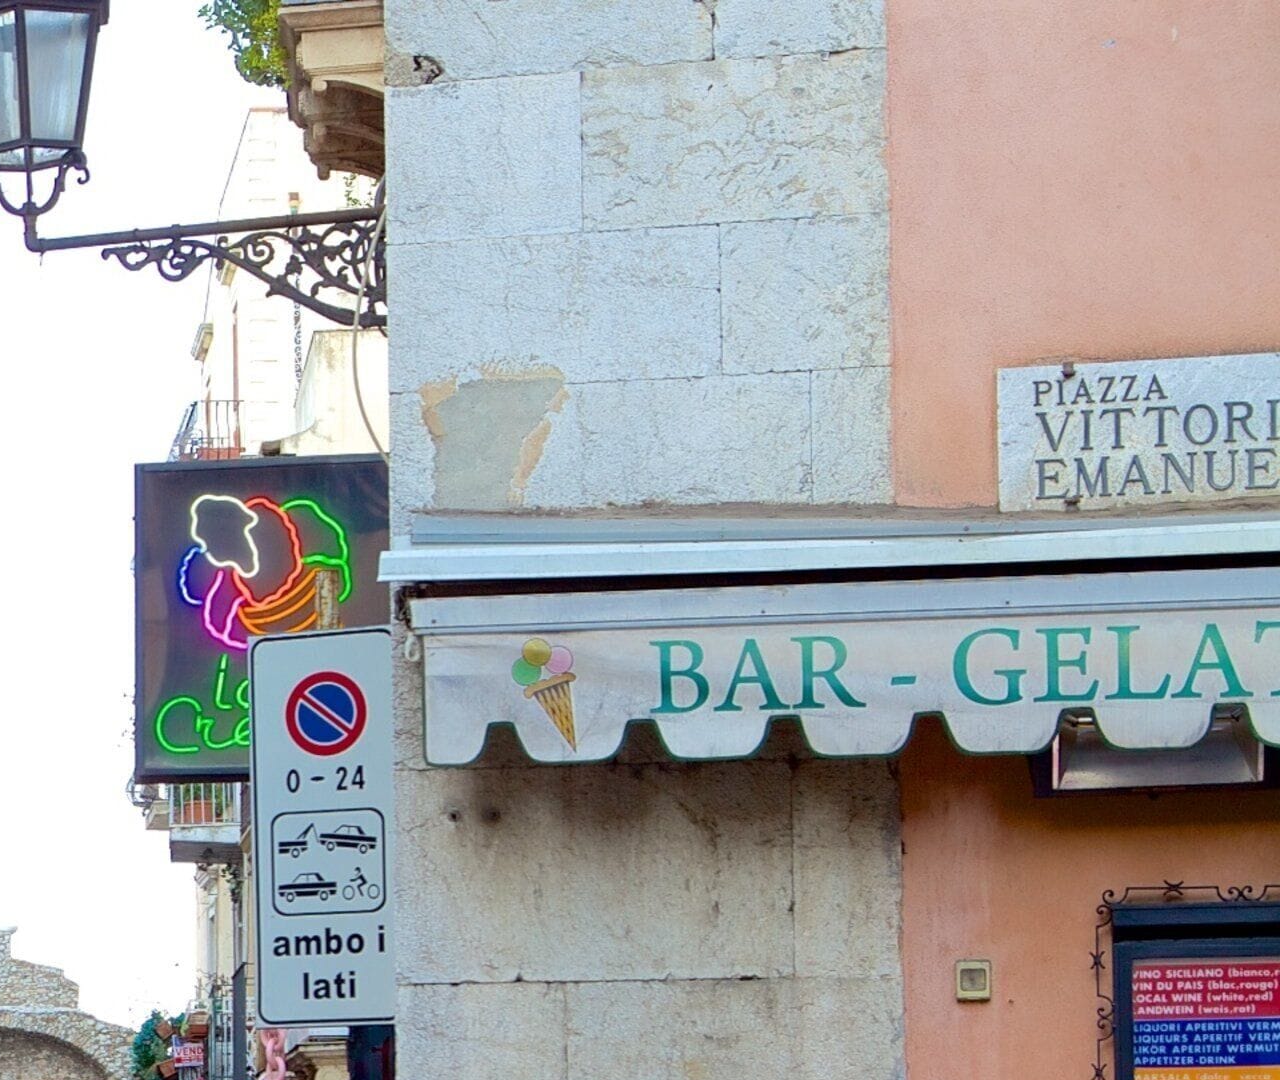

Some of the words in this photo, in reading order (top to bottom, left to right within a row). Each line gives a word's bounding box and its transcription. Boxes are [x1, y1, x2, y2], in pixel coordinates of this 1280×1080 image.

[1032, 374, 1169, 407] PIAZZA
[1035, 399, 1280, 452] VITTORI
[1035, 448, 1280, 500] EMANUE
[649, 636, 867, 715] BAR
[891, 675, 915, 686] -
[287, 769, 301, 793] 0
[336, 765, 366, 792] 24
[273, 927, 365, 957] ambo
[377, 925, 386, 953] i
[1165, 968, 1224, 979] SICILIANO
[302, 971, 356, 1000] lati
[1157, 981, 1174, 991] DU
[1177, 980, 1204, 990] PAIS
[1172, 993, 1203, 1002] WINE
[1134, 1005, 1194, 1015] ANDWEIN
[1133, 1023, 1180, 1032] LIQUORI
[1185, 1022, 1243, 1032] APERITIVI
[1133, 1034, 1189, 1044] LIQUEURS
[1193, 1033, 1243, 1043] APERITIF
[1172, 1044, 1221, 1054] APERITIF
